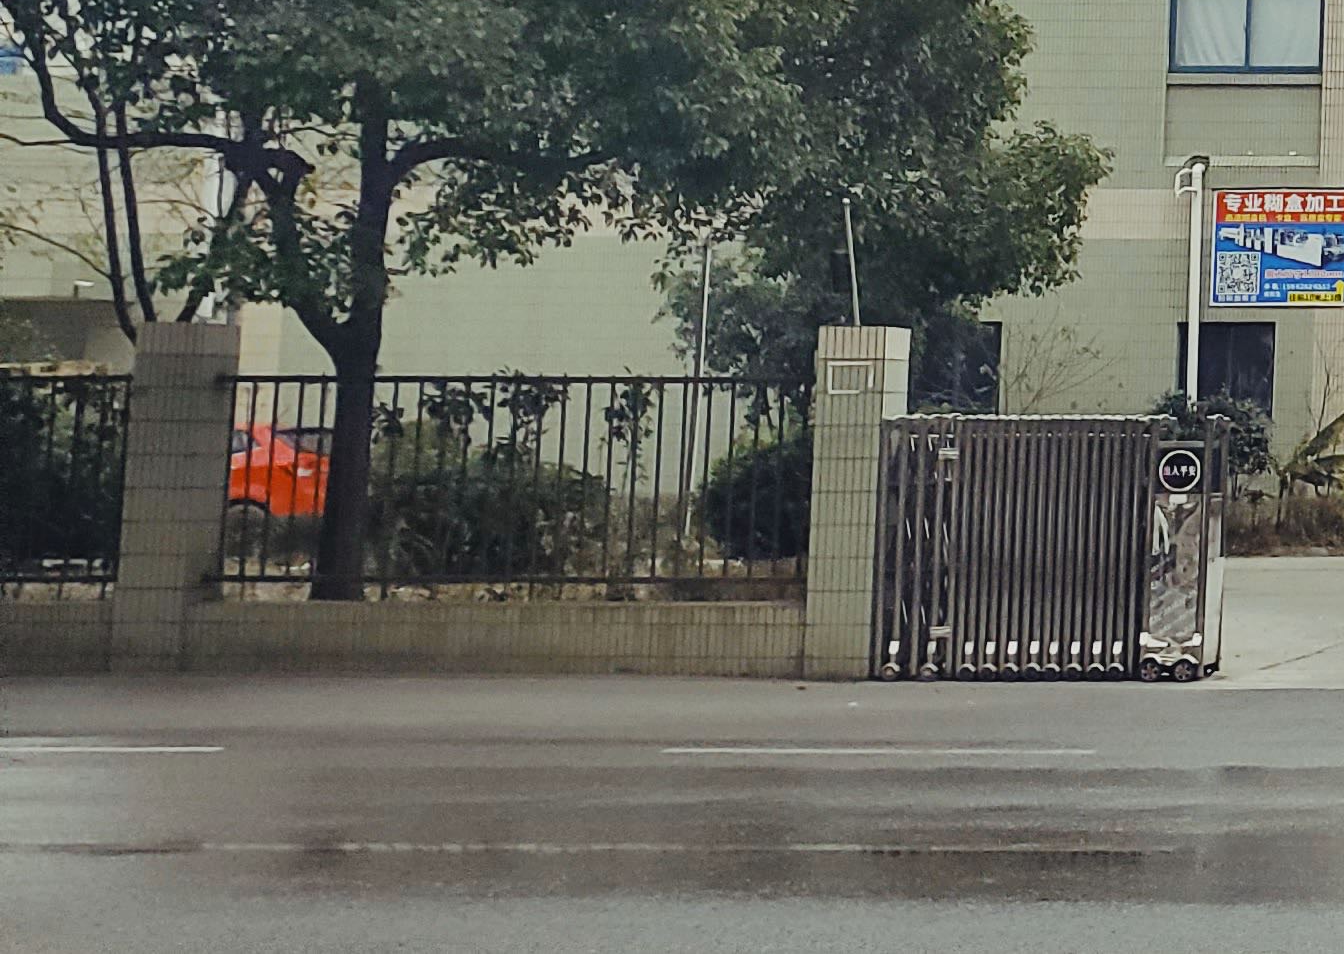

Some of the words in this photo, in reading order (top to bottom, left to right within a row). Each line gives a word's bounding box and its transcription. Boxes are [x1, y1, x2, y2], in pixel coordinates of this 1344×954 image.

[1223, 194, 1344, 212] 专业糊盒加工
